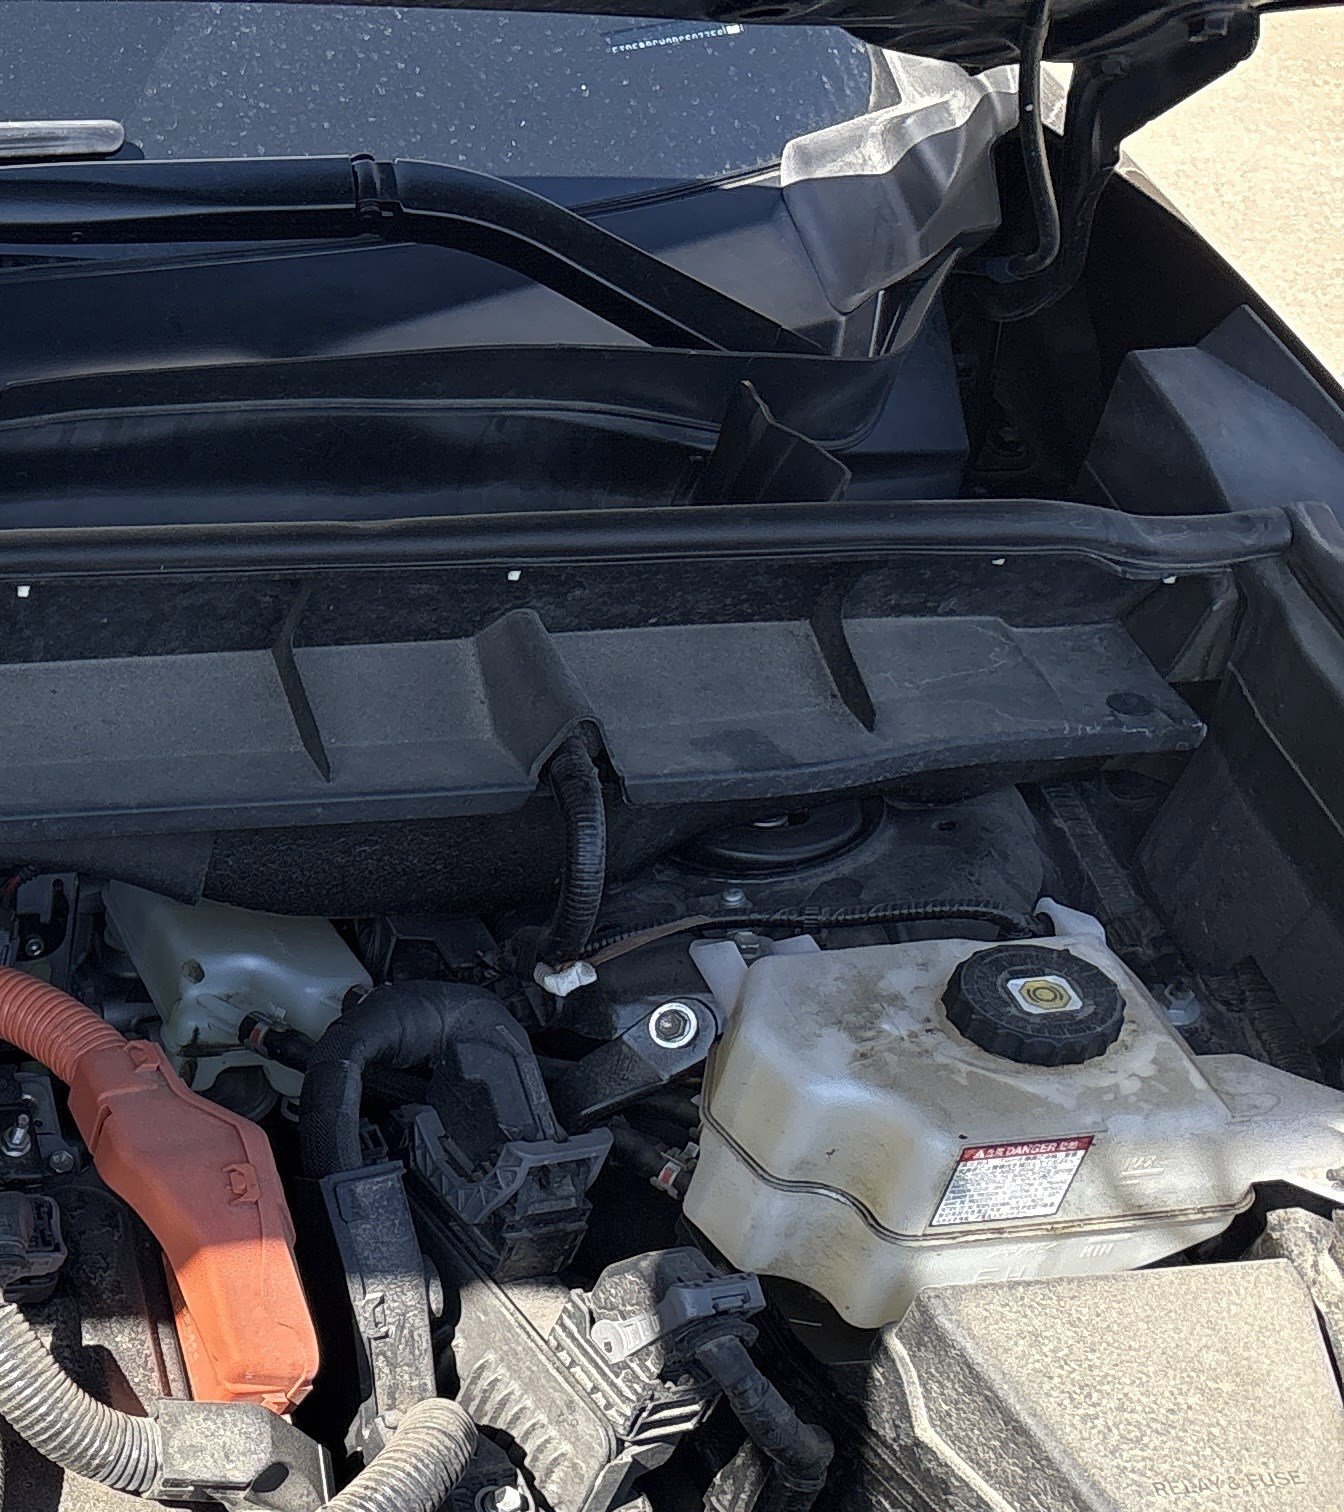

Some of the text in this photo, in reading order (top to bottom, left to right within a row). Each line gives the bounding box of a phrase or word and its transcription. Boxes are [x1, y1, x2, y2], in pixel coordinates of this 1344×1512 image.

[1005, 1142, 1057, 1156] DANGER
[1152, 1469, 1306, 1497] RELAY & FUSE
